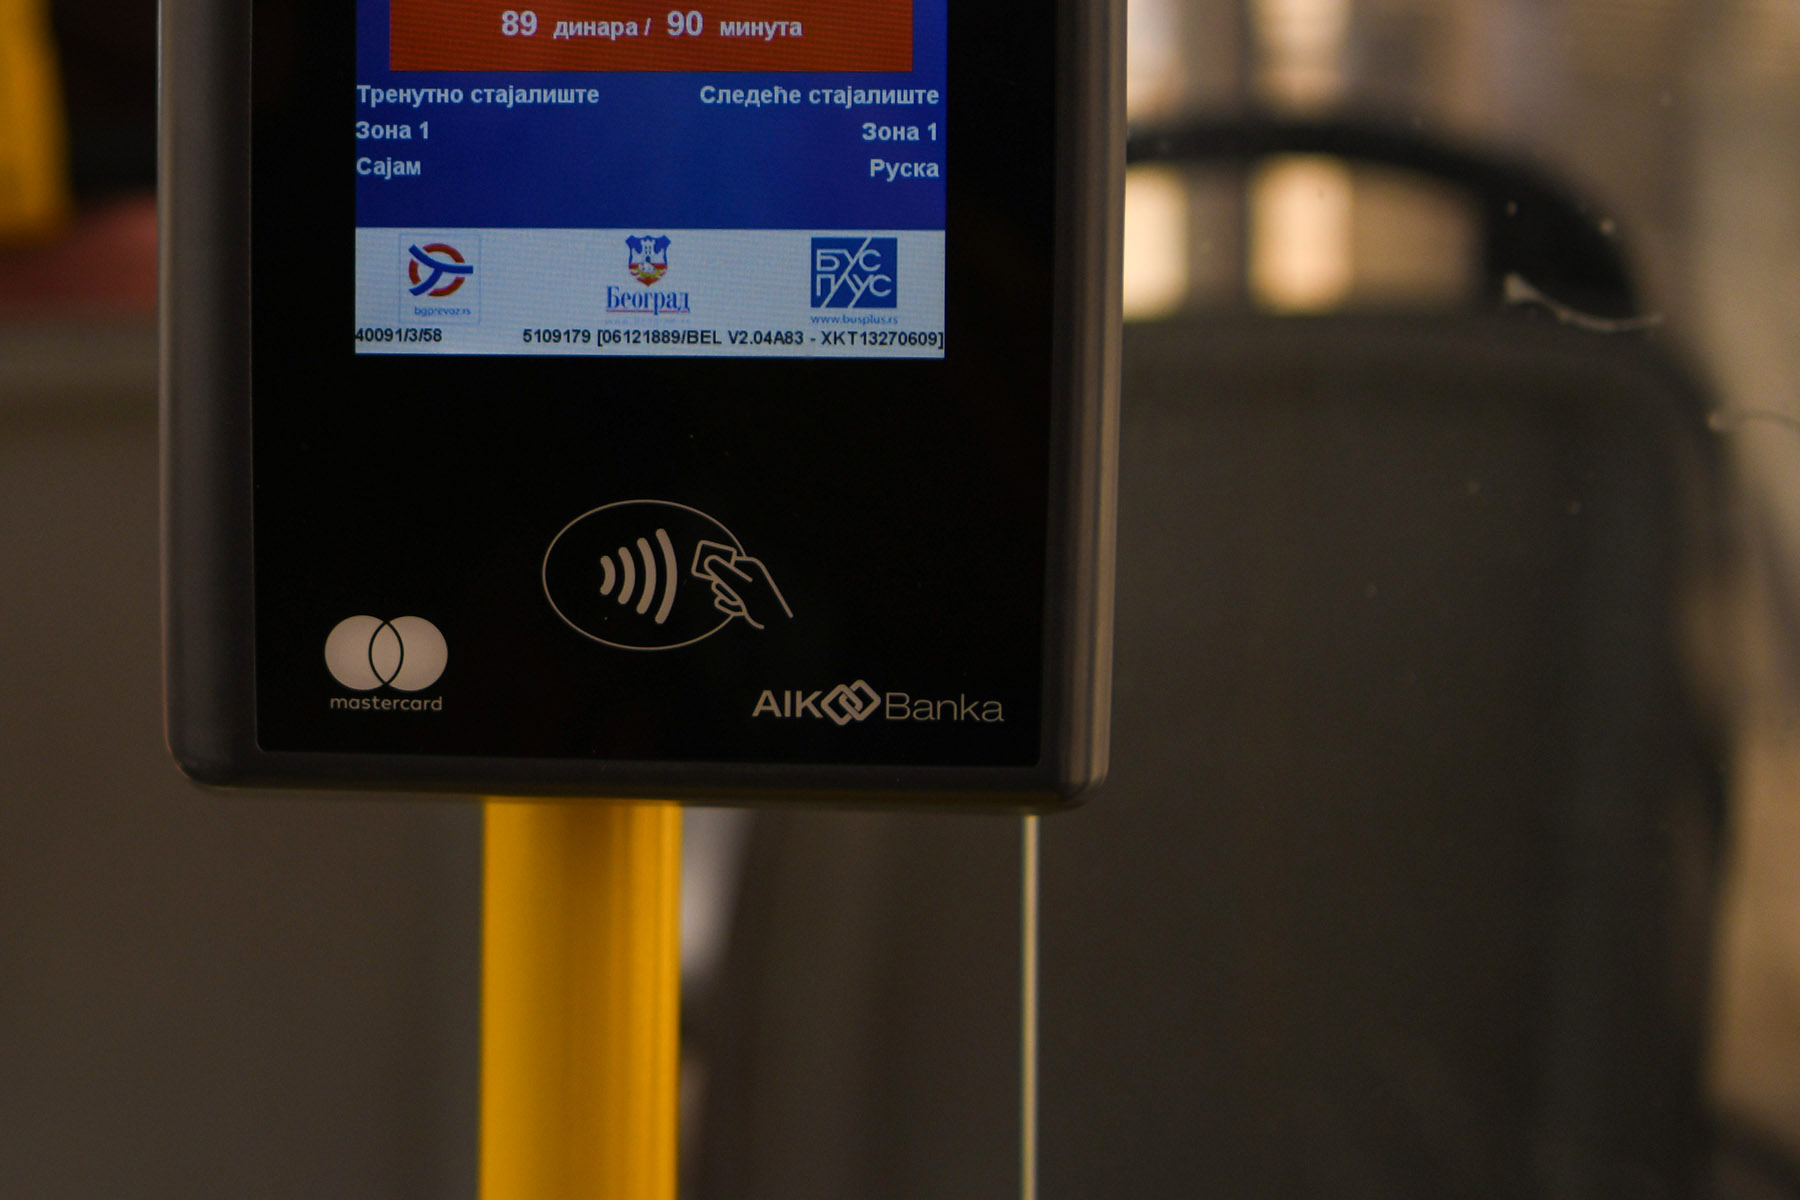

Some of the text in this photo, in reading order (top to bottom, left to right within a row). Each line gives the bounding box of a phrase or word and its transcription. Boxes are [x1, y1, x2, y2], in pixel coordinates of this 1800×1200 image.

[501, 11, 538, 37] 89
[553, 17, 638, 39] динара
[666, 11, 703, 37] 90
[720, 18, 803, 40] минута
[357, 85, 600, 108] Тренутно стајалиште
[700, 85, 940, 109] Следеће стајалиште
[355, 122, 430, 140] Зона 1
[862, 123, 938, 142] Зона 1
[356, 157, 421, 180] Сајам
[869, 159, 939, 182] Руска
[606, 285, 690, 315] Београд
[810, 314, 899, 325] www.busplus.rs
[355, 328, 443, 343] 40091/3/58
[523, 328, 591, 344] 5109179
[597, 329, 721, 347] [06121889/BEL
[728, 331, 804, 345] V2.04A83
[821, 331, 944, 350] XKT13270609]
[330, 696, 443, 711] mastercard
[752, 690, 1005, 722] AIK Banka
